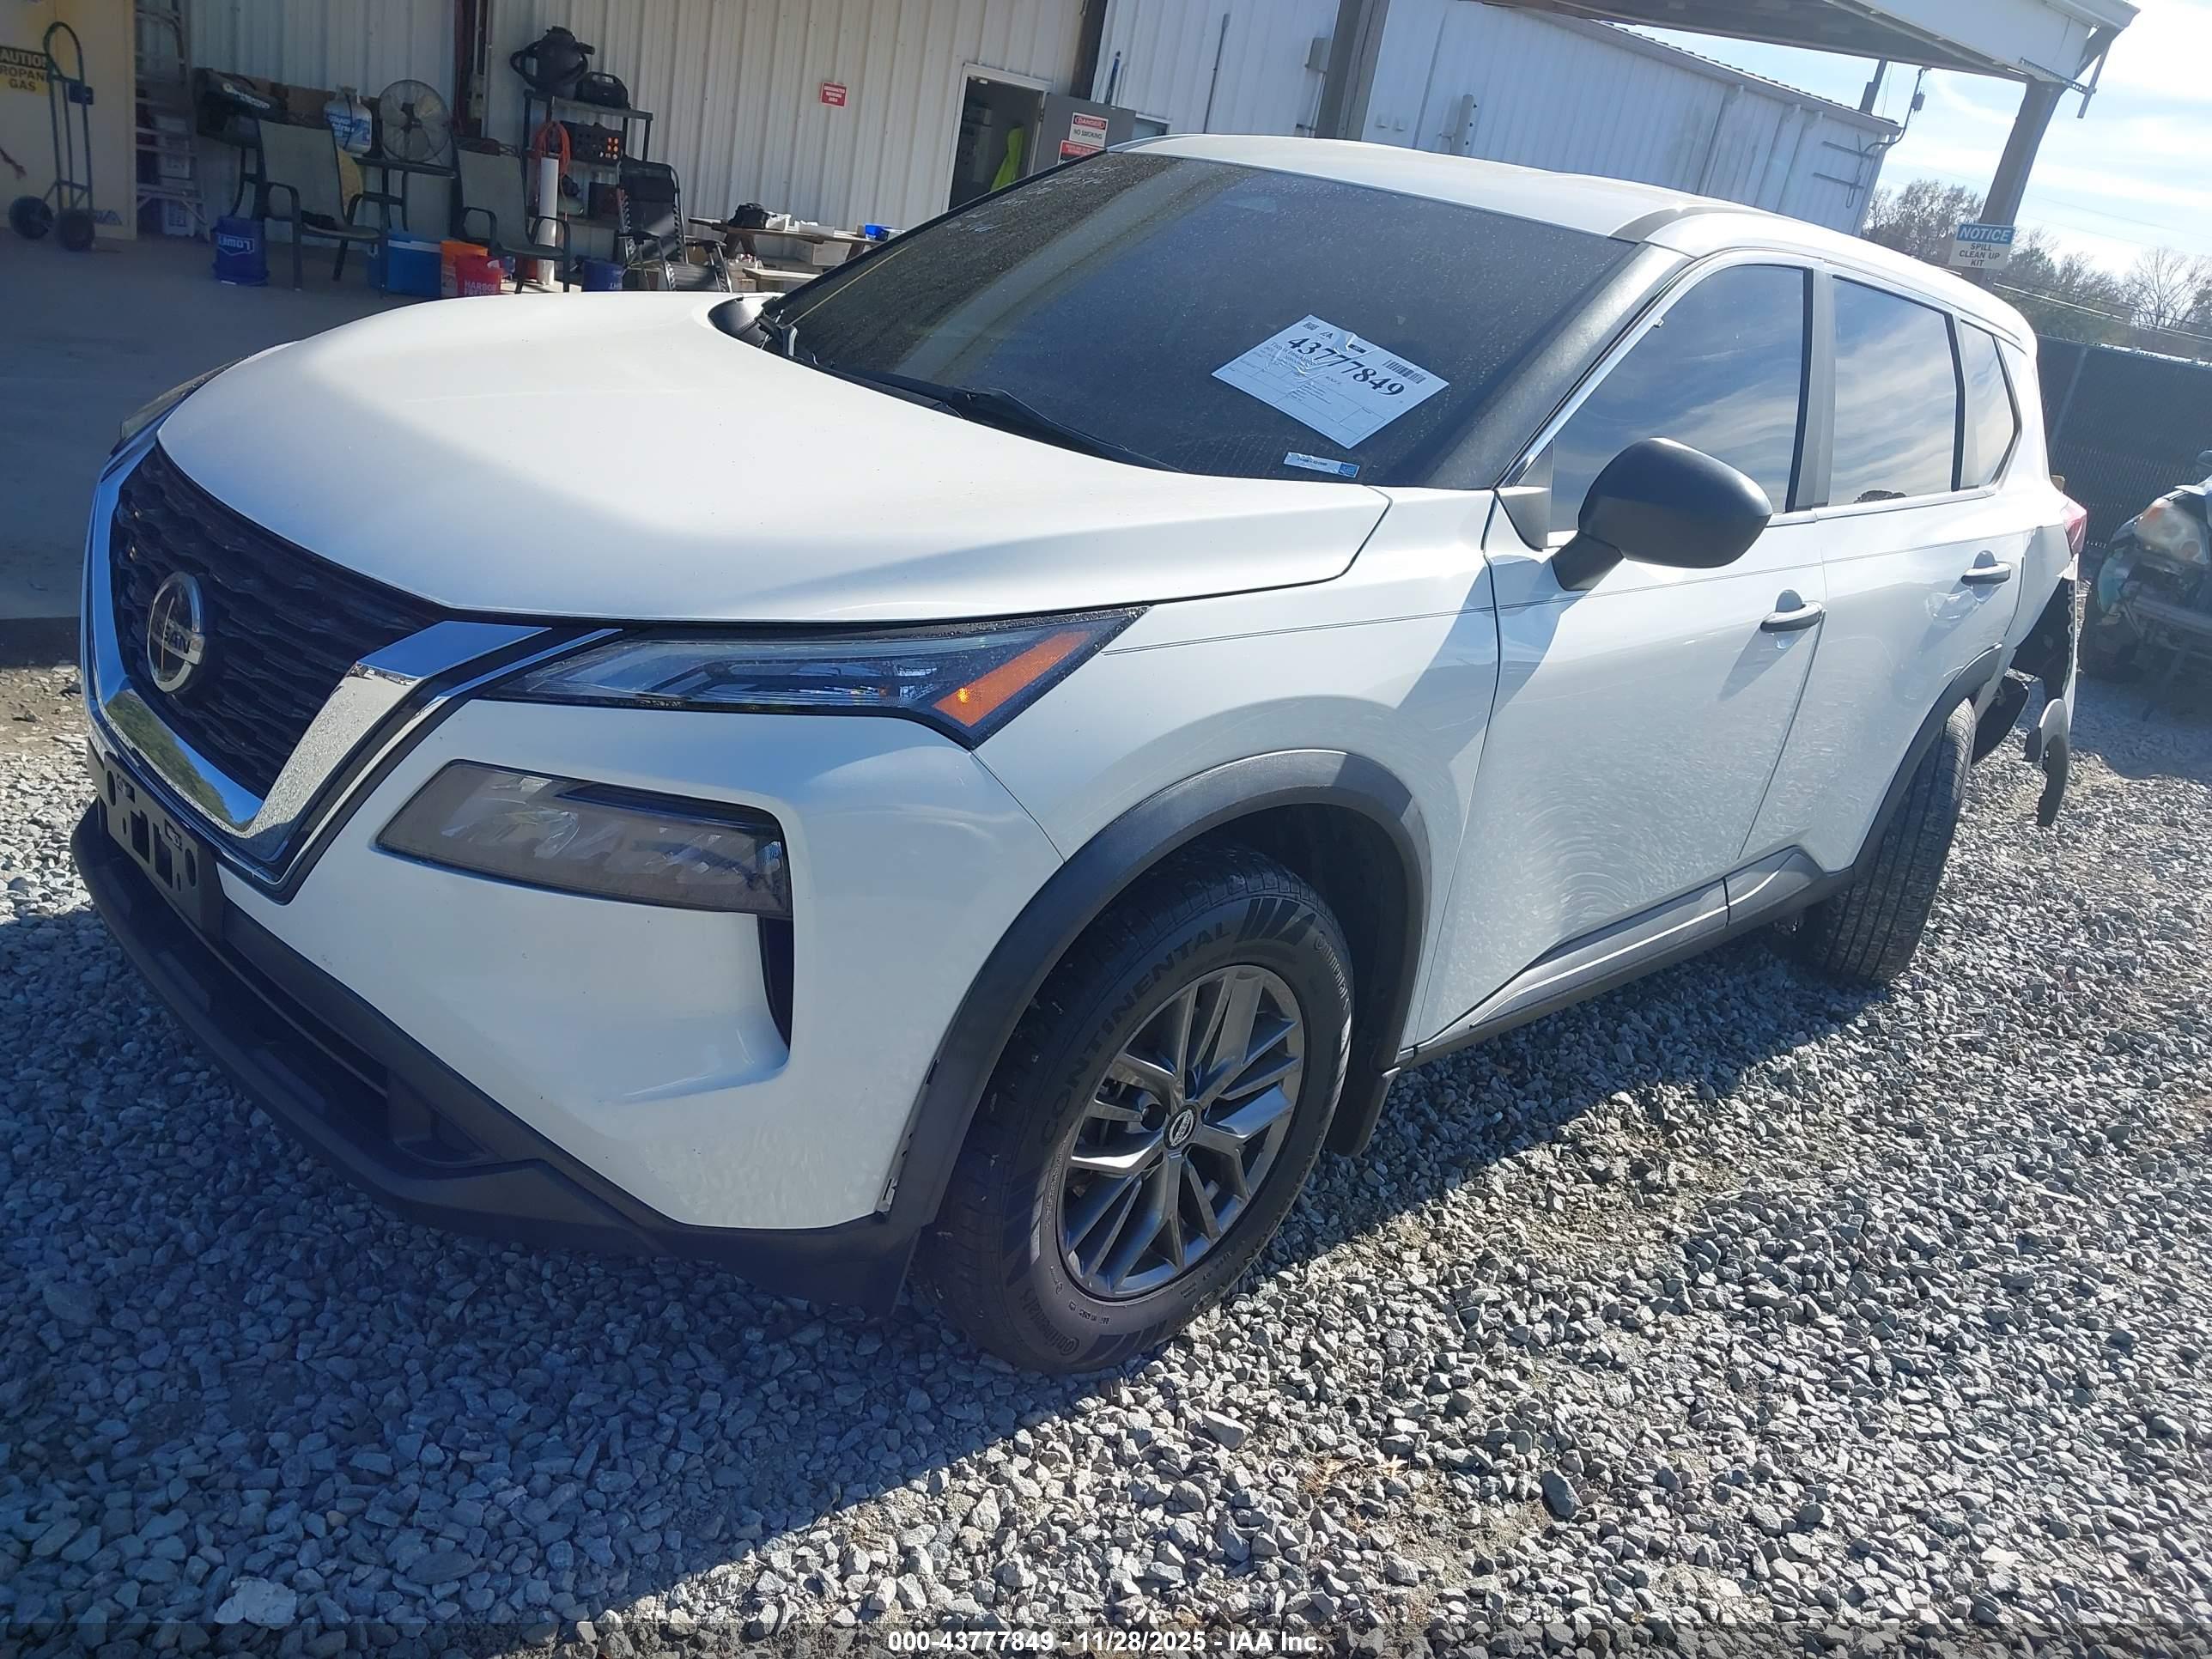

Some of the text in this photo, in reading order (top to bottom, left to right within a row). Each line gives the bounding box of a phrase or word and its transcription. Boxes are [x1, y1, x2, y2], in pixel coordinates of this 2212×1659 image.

[0, 48, 46, 68] AUTIO
[0, 64, 45, 82] ROPAN
[9, 78, 36, 92] GAS
[1081, 130, 1103, 140] SMOKING
[1959, 227, 2012, 241] NOTICE
[1970, 242, 1992, 252] SPILL
[1959, 250, 2001, 260] CLEAN UP
[1970, 258, 1984, 267] KIT
[464, 280, 496, 293] HARBOR
[1288, 337, 1405, 396] 43777849
[1042, 921, 1231, 1145] CONTINENTAL
